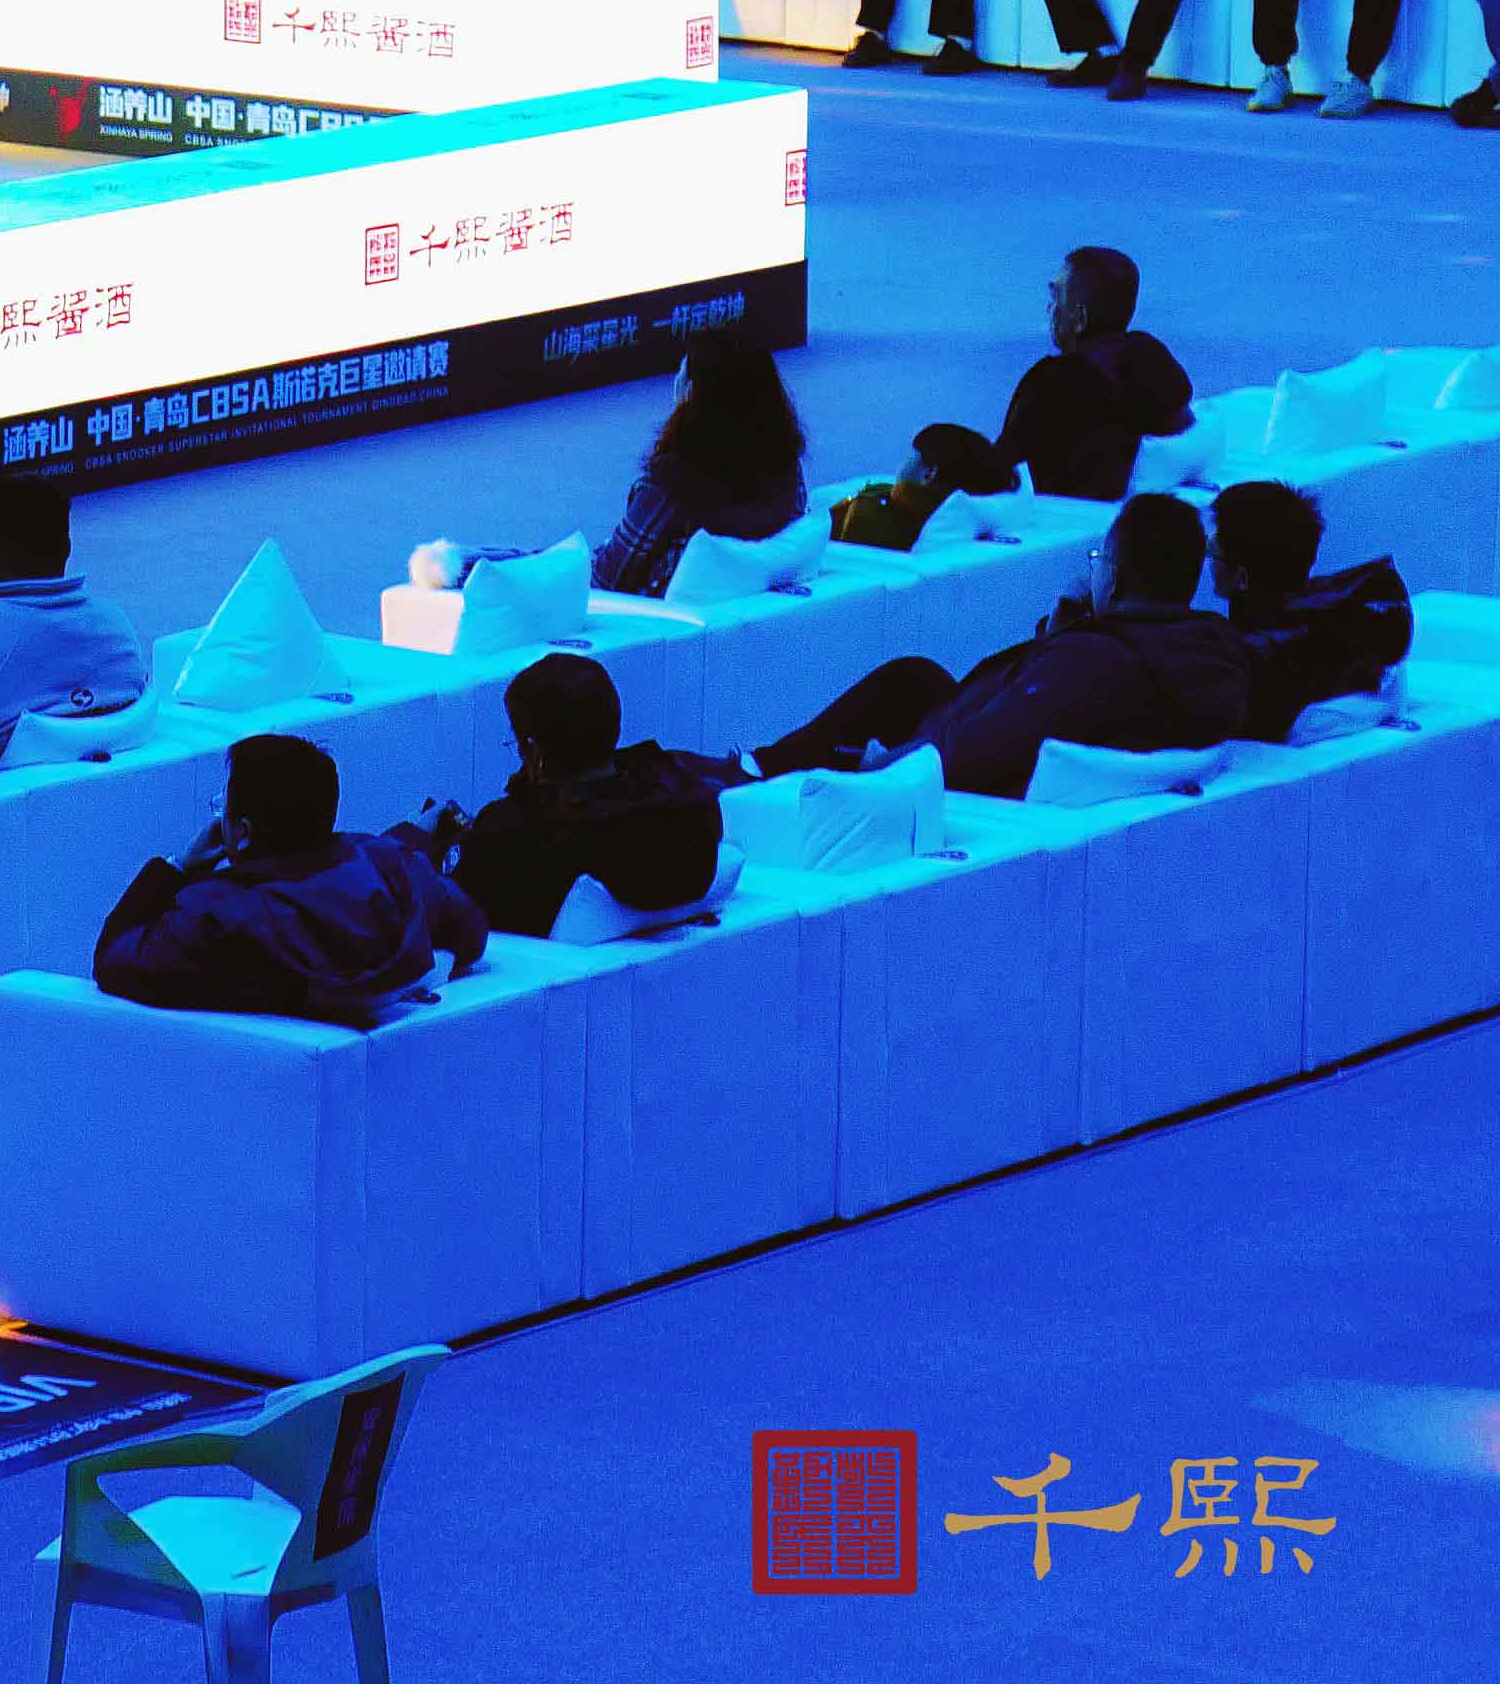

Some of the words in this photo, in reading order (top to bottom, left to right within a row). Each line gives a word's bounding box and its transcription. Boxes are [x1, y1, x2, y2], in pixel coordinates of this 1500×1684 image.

[272, 6, 458, 60] 千熙酱酒
[99, 85, 173, 125] 涵养山
[409, 201, 576, 269] 千熙酱酒
[542, 314, 640, 365] 山海聚星光
[651, 290, 746, 341] 一杆定乾坤
[2, 415, 75, 466] 涵养山
[87, 340, 450, 448] 中国·青岛CBSA斯诺克巨星邀请赛
